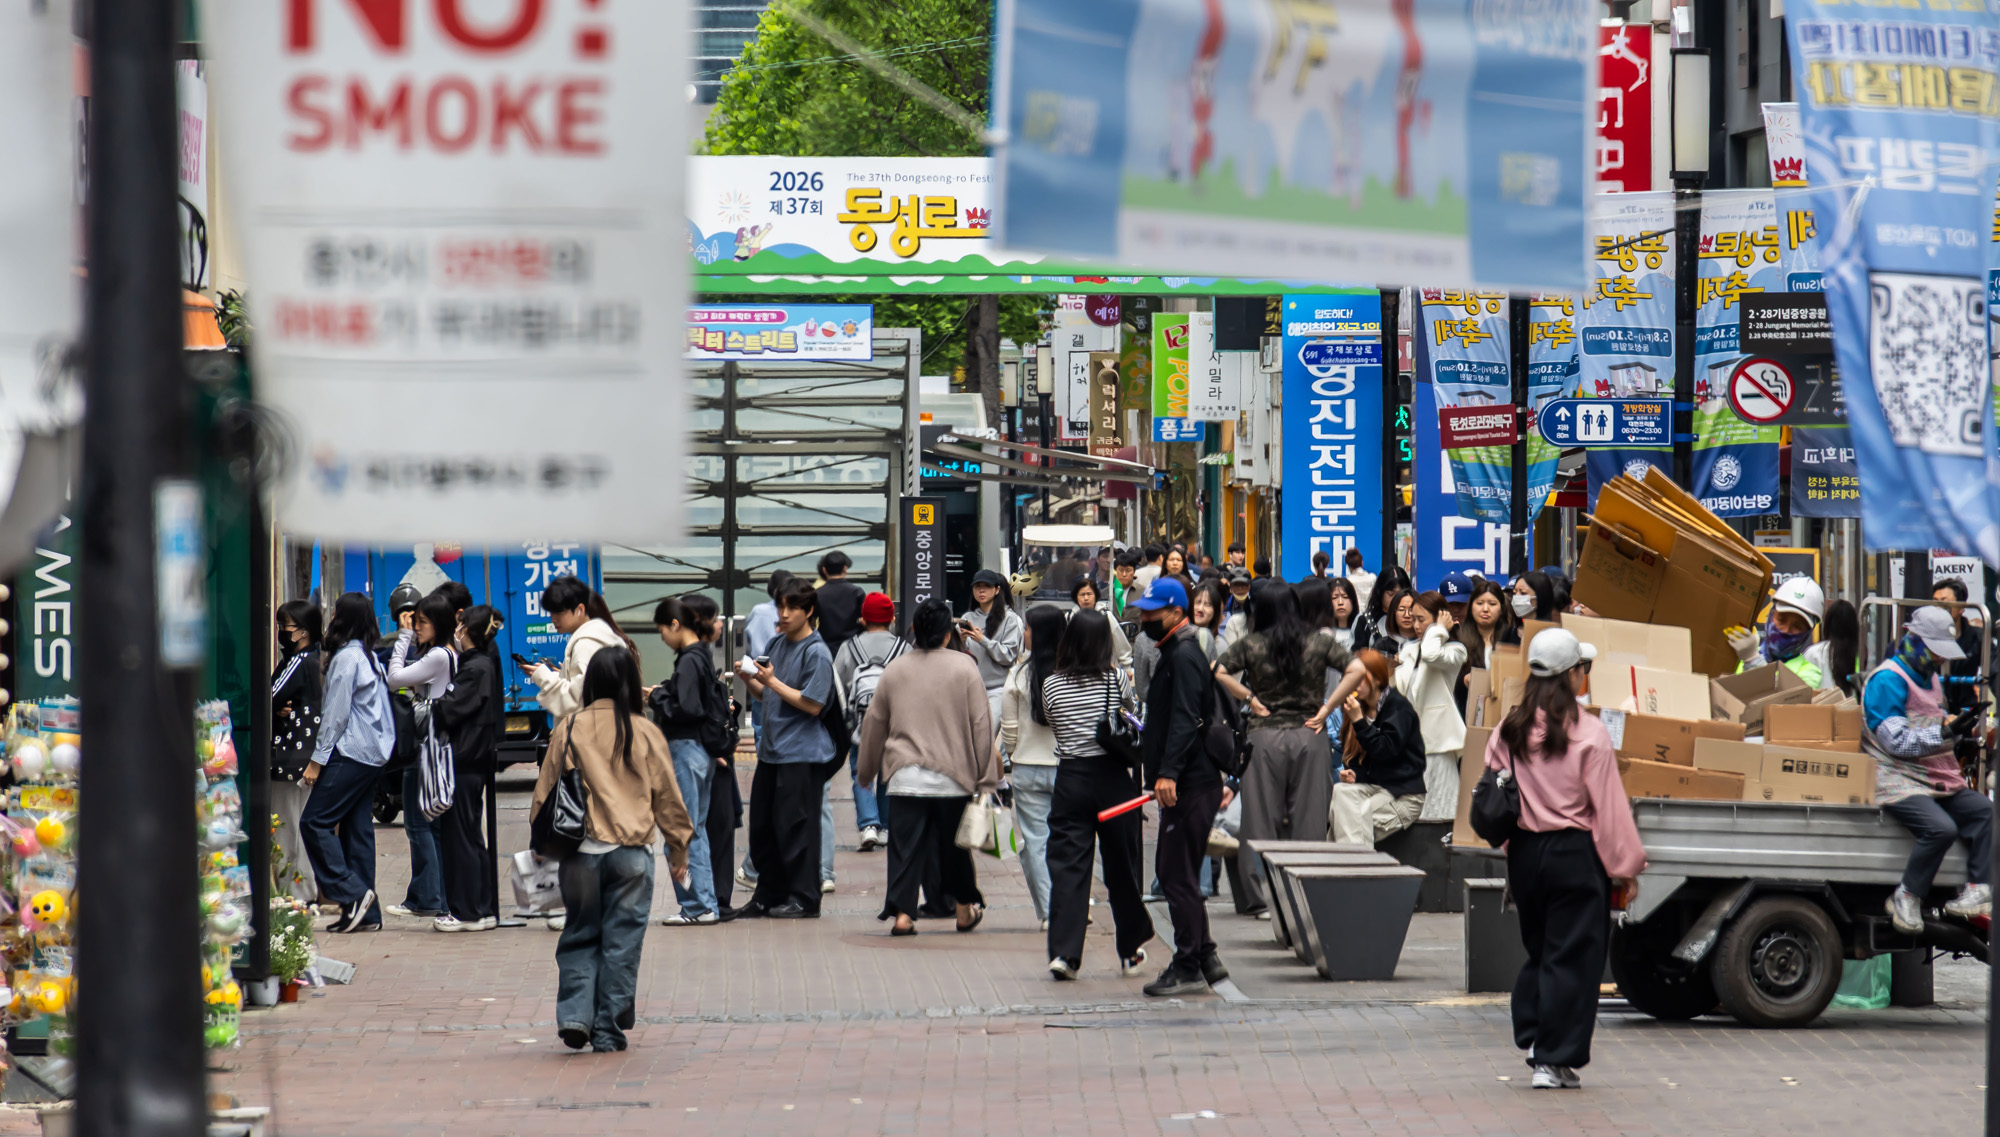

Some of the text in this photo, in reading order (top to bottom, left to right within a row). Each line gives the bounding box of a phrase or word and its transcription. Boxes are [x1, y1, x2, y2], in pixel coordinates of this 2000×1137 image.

[285, 74, 608, 154] SMOKE
[769, 171, 823, 192] 2026
[847, 173, 865, 182] The
[868, 173, 891, 182] 37th
[894, 173, 967, 184] Dongseong-ro
[769, 200, 783, 215] 제
[837, 188, 980, 257] 동성로
[1095, 306, 1119, 320] 예인
[1764, 322, 1790, 330] Jungang
[727, 330, 797, 349] 스트리트
[1326, 345, 1372, 355] 국채보상로
[1208, 333, 1223, 400] 사밀라
[1102, 384, 1116, 430] 럭셔리
[1622, 403, 1662, 413] 개방화장실
[1935, 564, 1974, 575] AKERY
